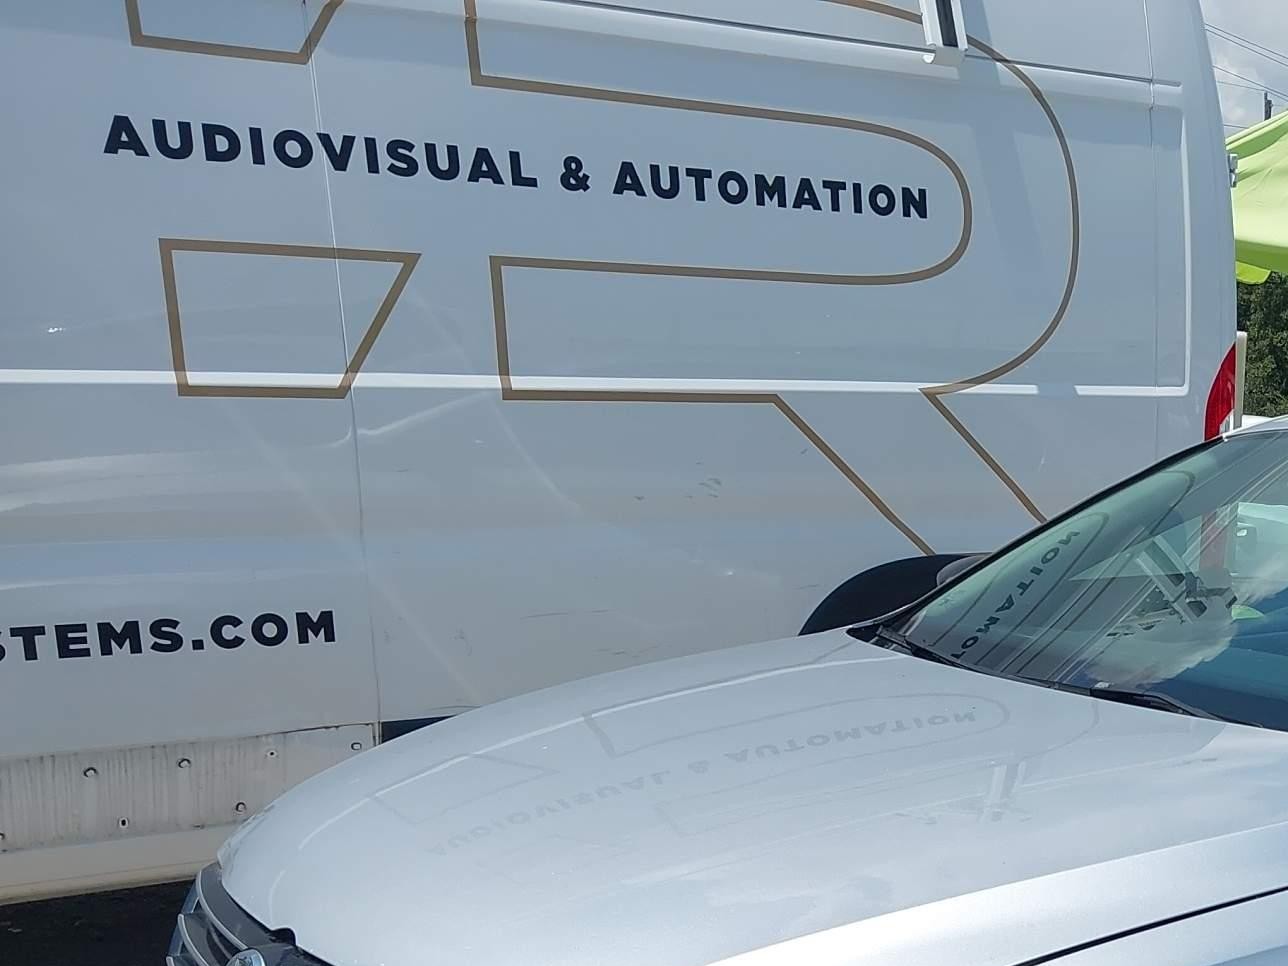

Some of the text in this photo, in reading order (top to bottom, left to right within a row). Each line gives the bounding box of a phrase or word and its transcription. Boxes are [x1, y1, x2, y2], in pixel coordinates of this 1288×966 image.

[103, 114, 928, 219] AUDIOVISUAL & AUTOMATION
[0, 610, 336, 662] TEMS.COM
